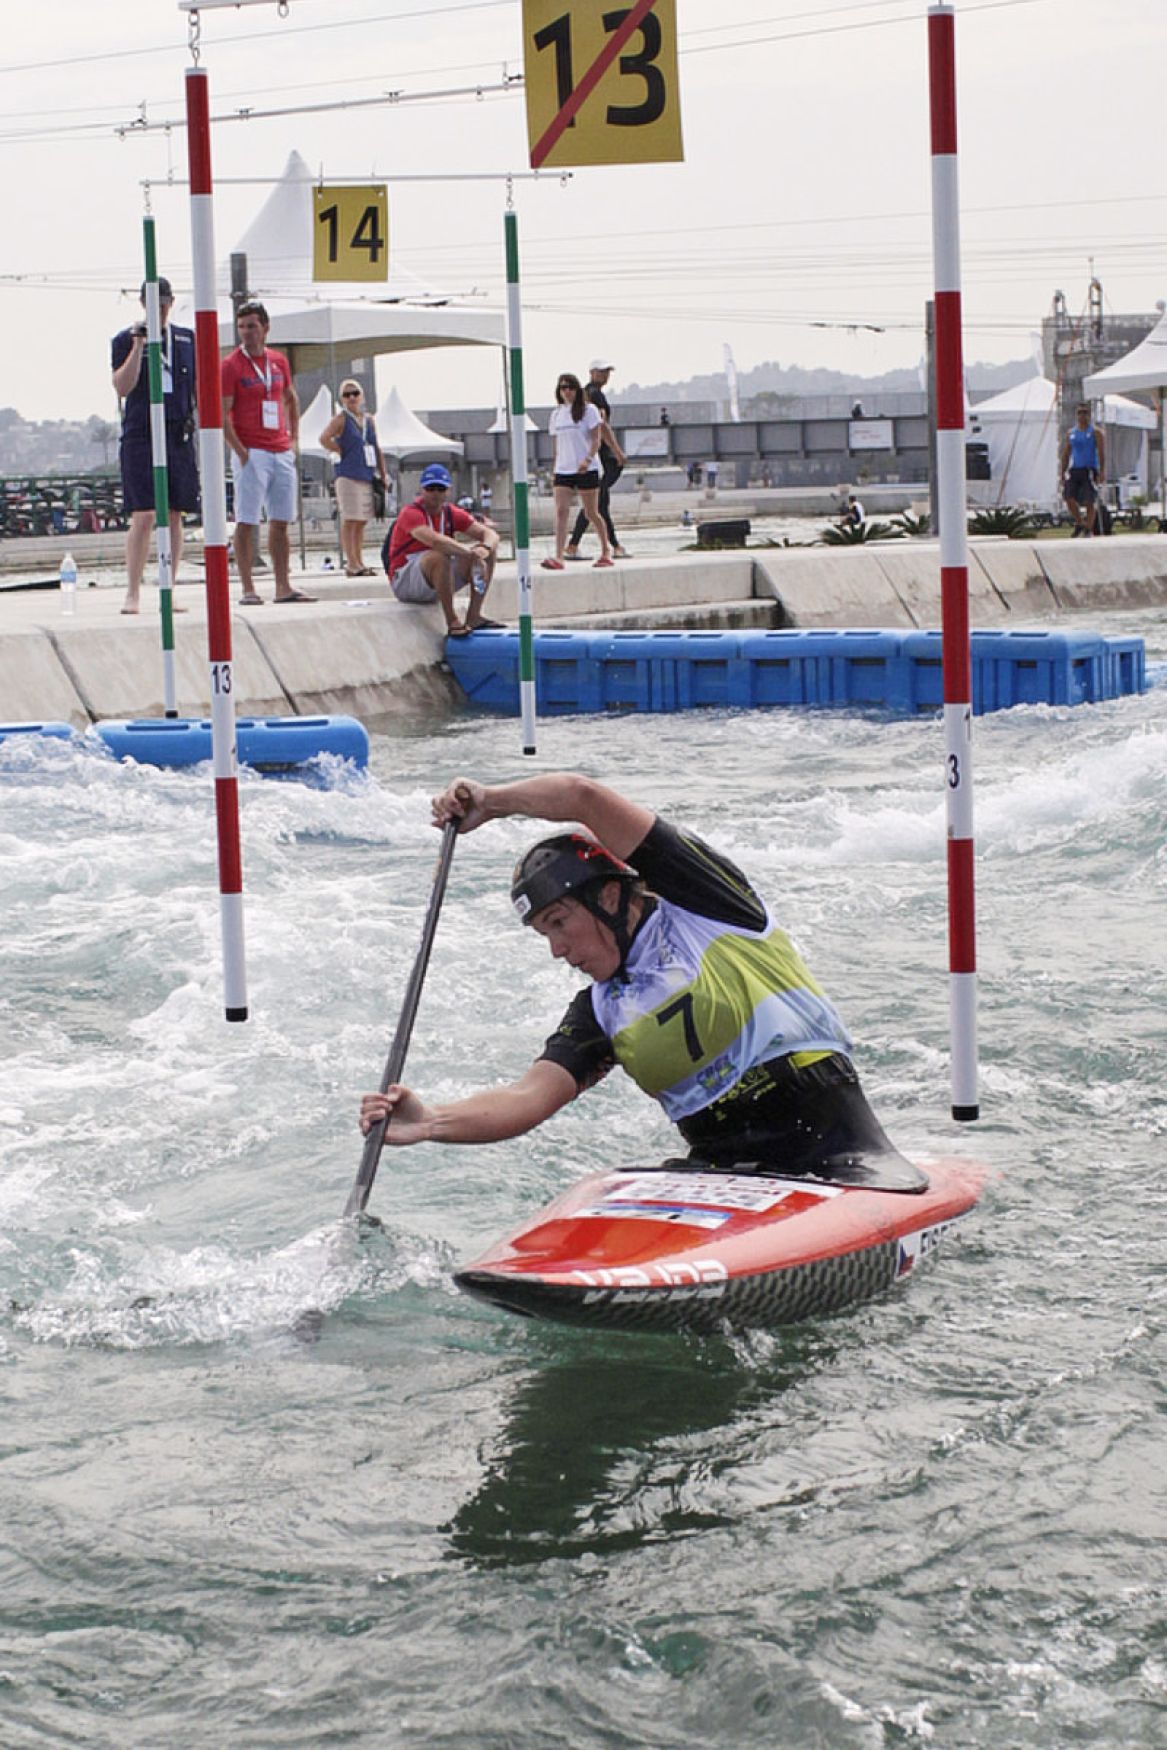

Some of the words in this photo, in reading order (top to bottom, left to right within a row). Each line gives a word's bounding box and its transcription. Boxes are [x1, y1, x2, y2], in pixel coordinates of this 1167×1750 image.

[533, 9, 666, 127] 13
[319, 204, 384, 262] 14
[212, 664, 232, 694] 13
[655, 991, 705, 1063] 7
